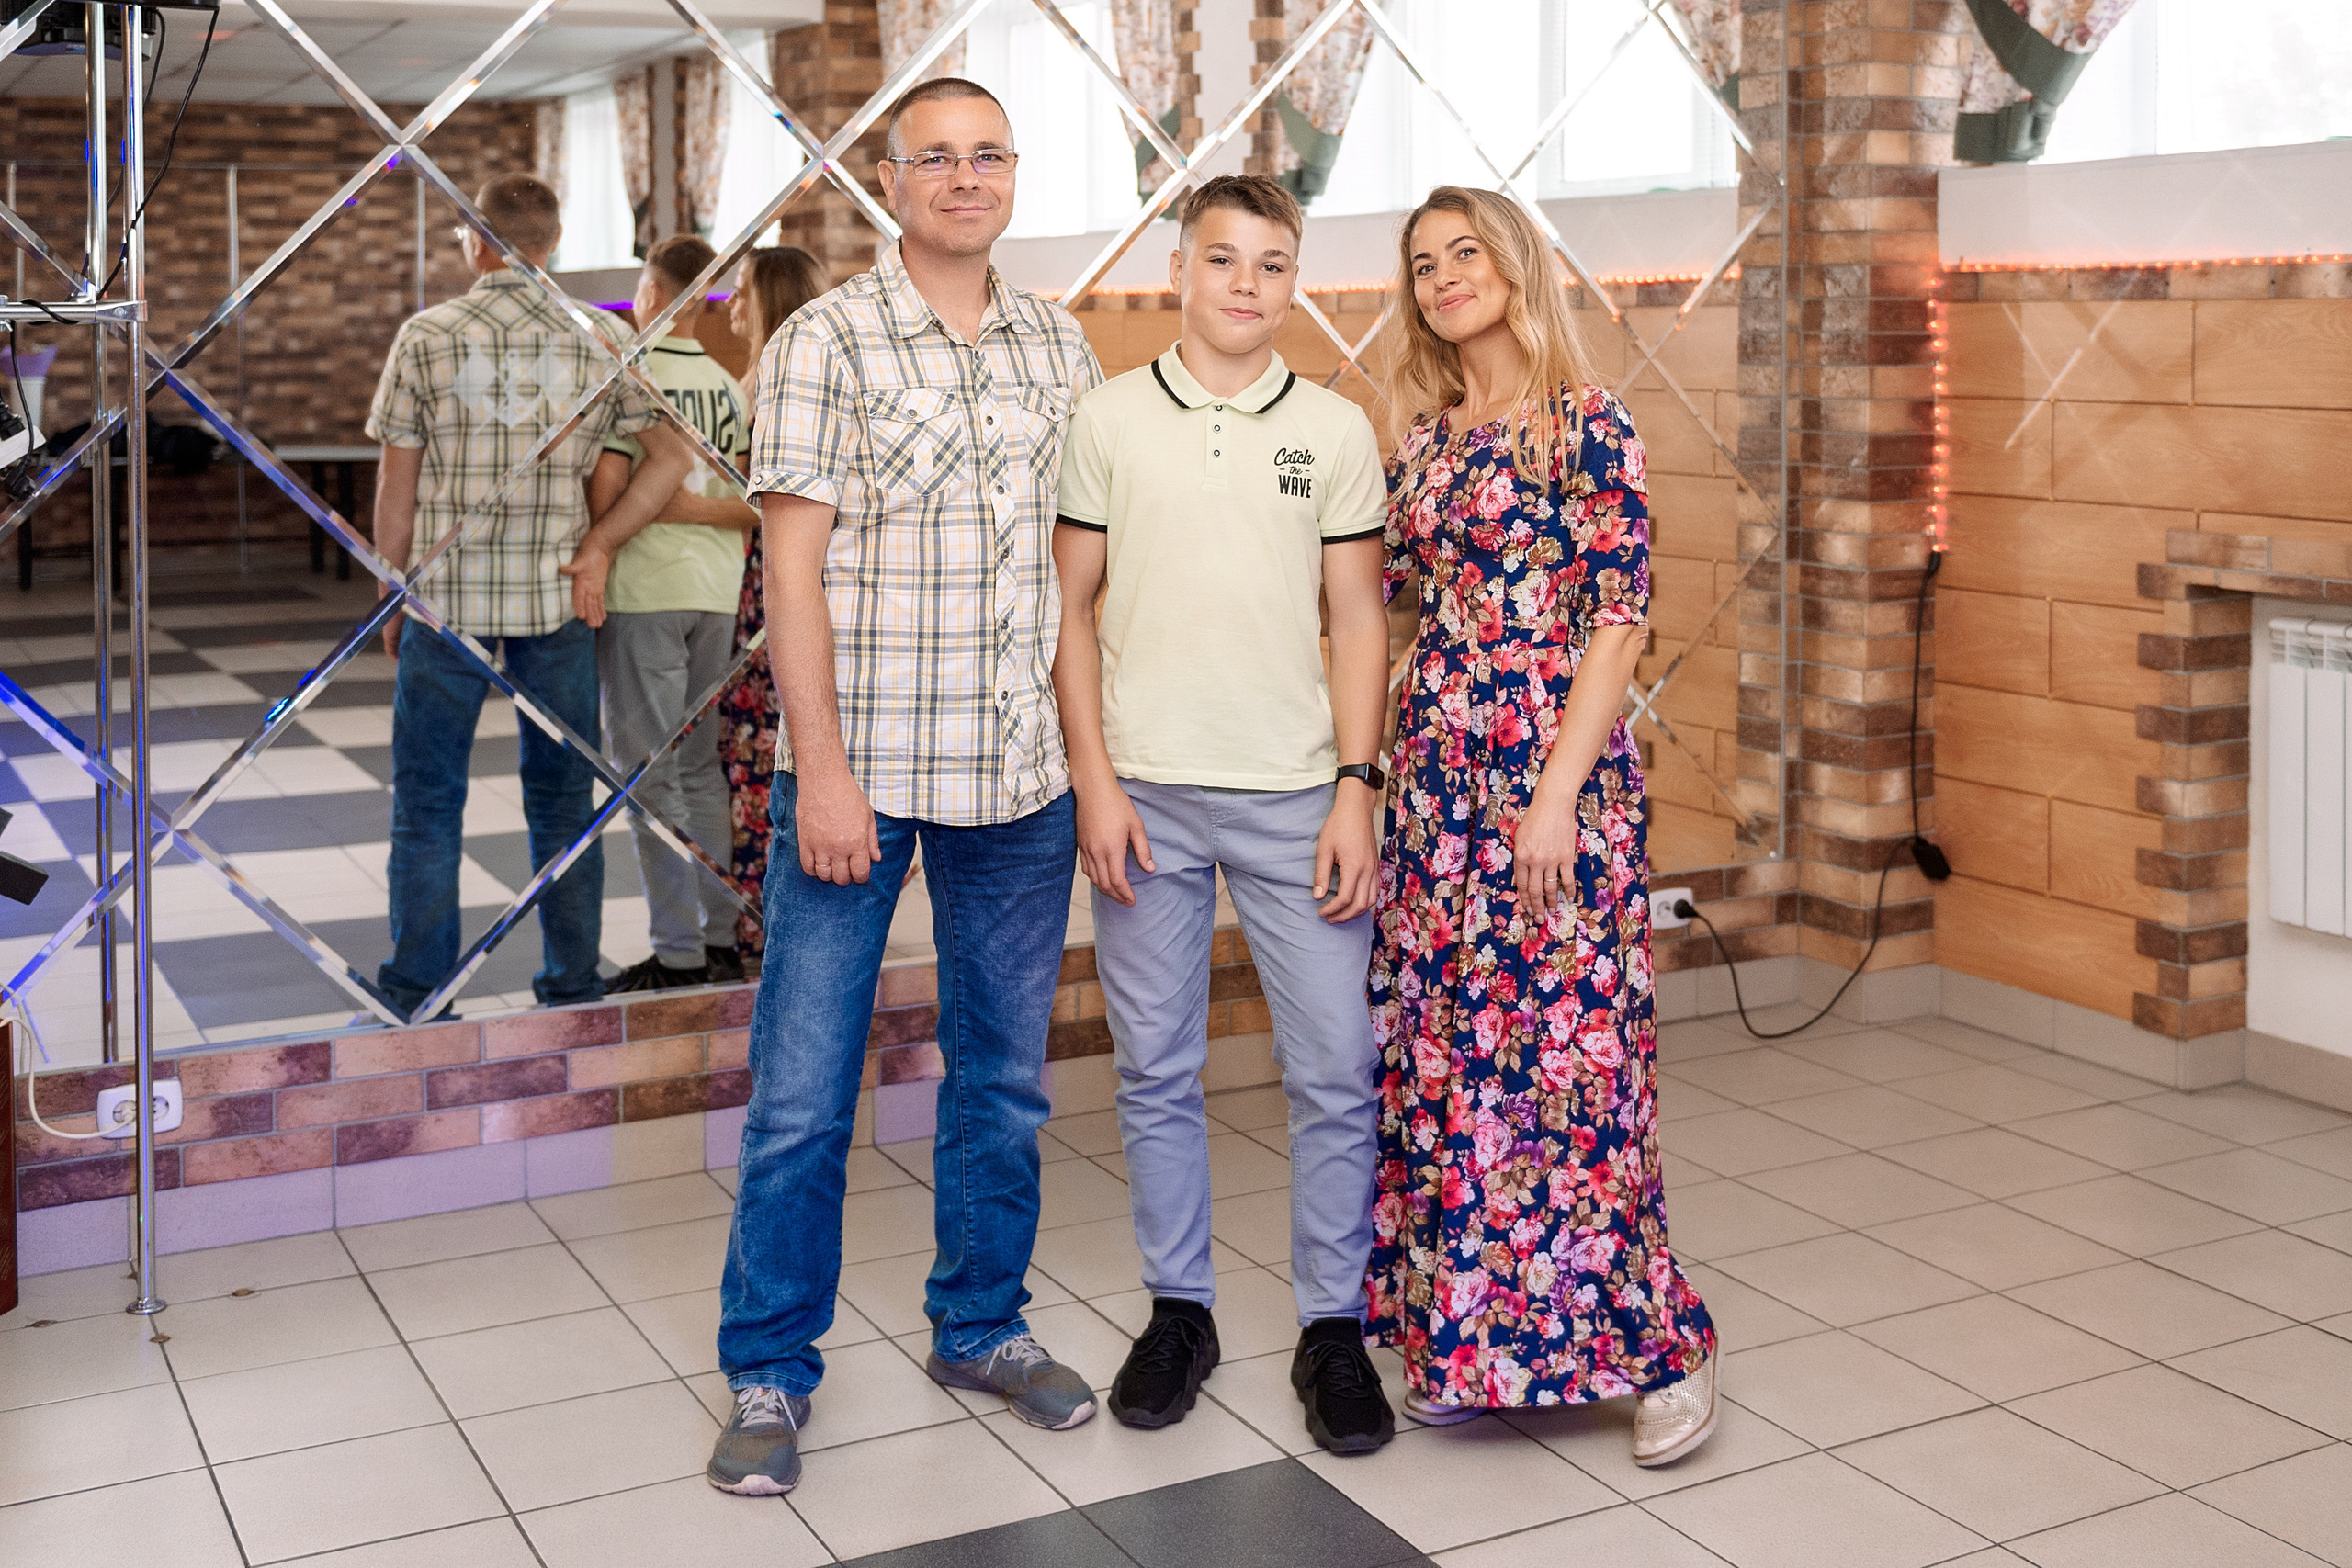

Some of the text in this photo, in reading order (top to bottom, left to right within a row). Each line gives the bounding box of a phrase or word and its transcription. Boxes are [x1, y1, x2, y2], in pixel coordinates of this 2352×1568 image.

[1274, 447, 1315, 466] Catch
[1289, 466, 1303, 475] the
[1278, 474, 1312, 498] WAVE
